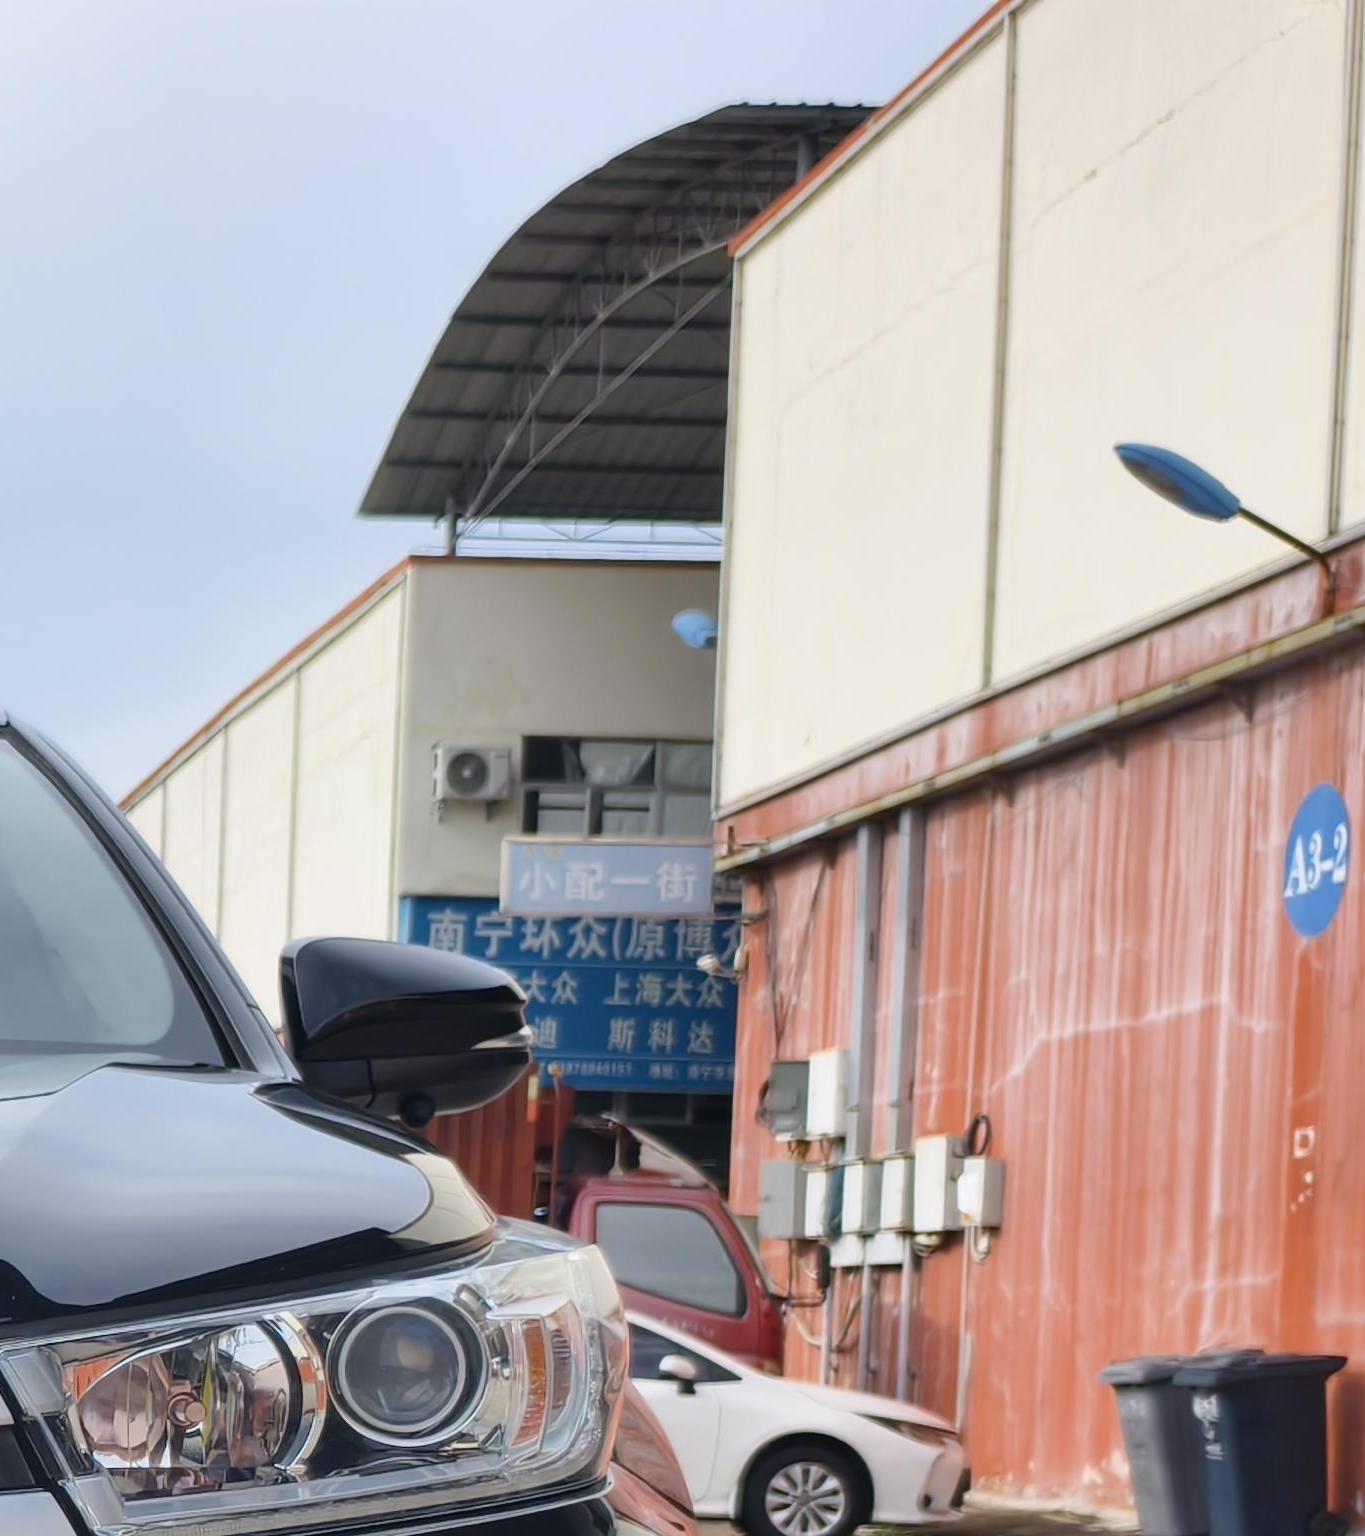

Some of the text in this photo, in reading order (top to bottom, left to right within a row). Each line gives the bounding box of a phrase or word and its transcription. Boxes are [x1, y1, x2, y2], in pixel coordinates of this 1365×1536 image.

[1284, 822, 1348, 898] A3-2
[518, 861, 698, 903] 小配一街
[603, 973, 725, 1008] 上海大众
